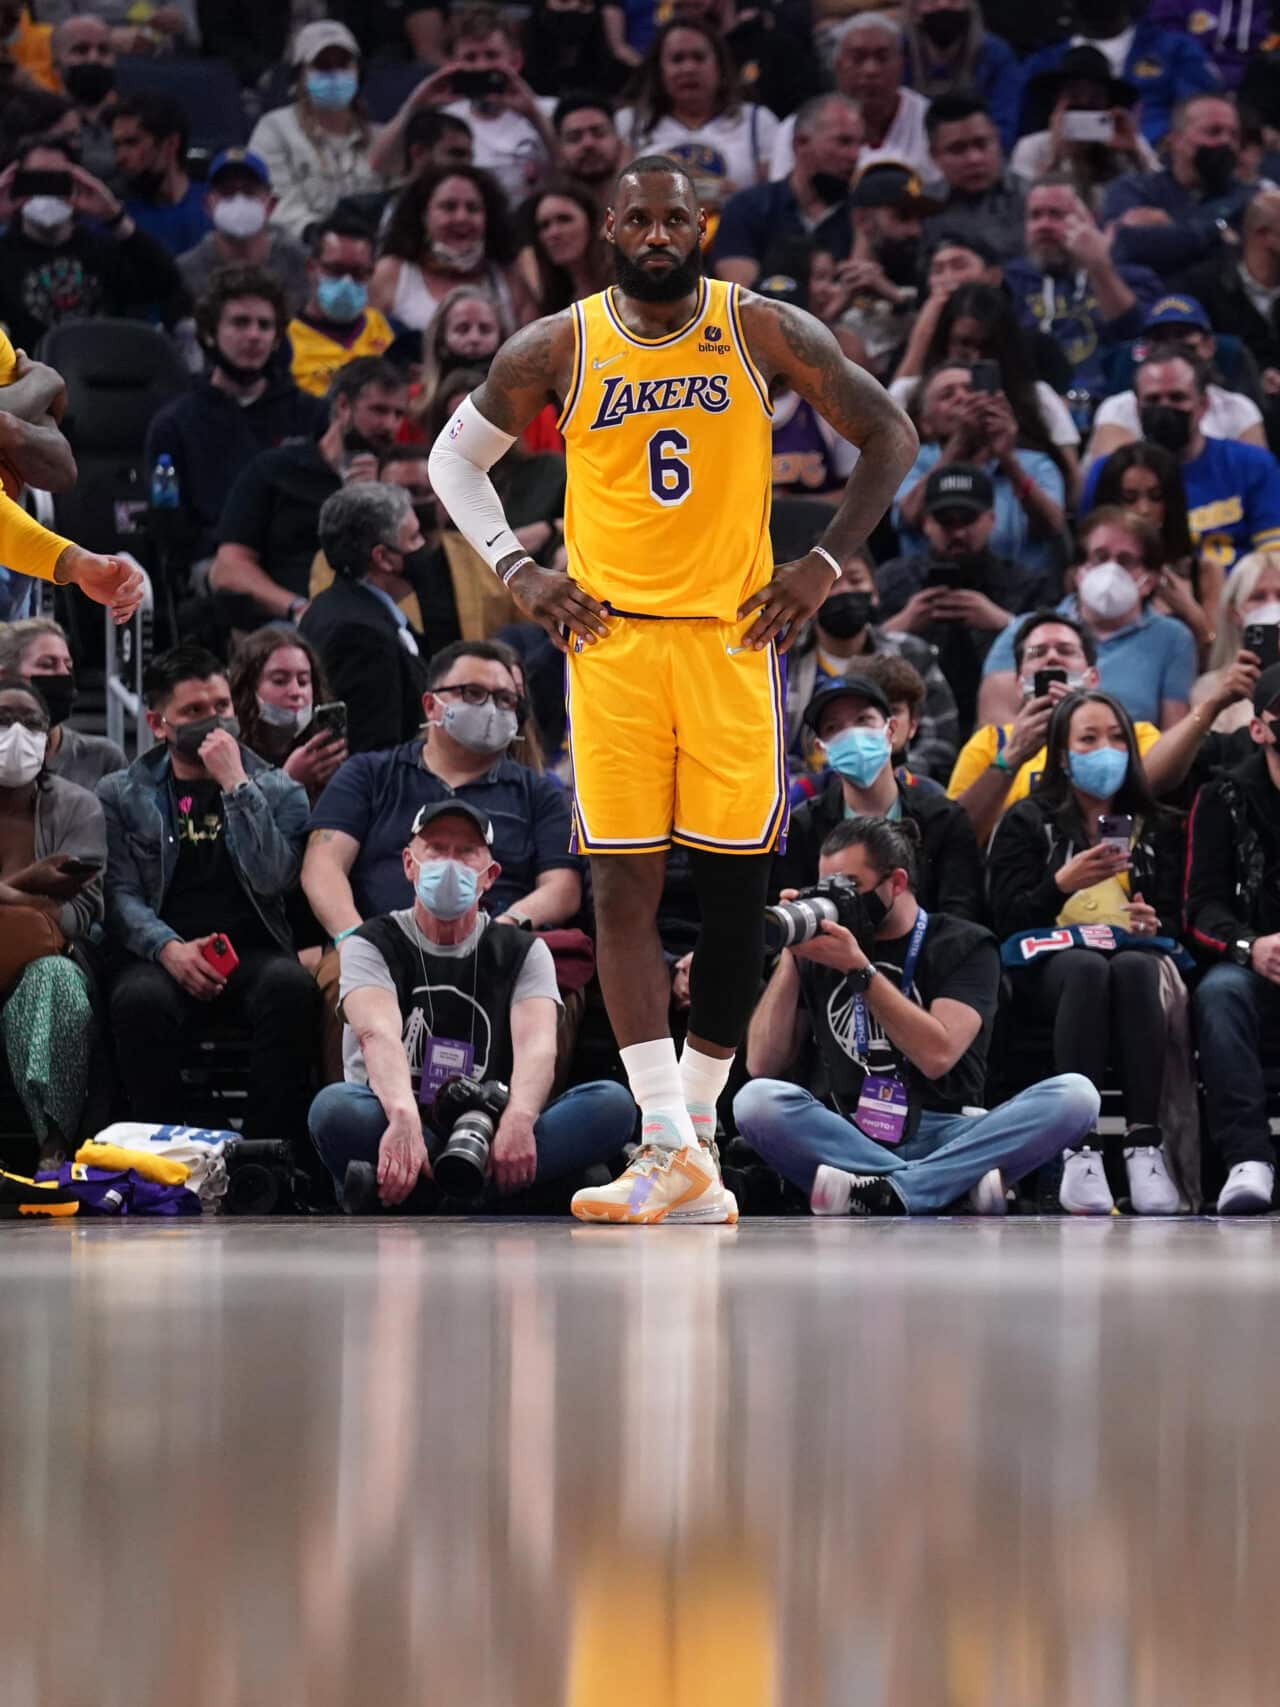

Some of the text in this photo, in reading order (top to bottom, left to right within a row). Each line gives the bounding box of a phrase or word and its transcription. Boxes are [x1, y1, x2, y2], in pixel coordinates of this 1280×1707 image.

[698, 343, 731, 355] bibigo
[589, 373, 732, 432] LAKERS
[647, 427, 692, 507] 6
